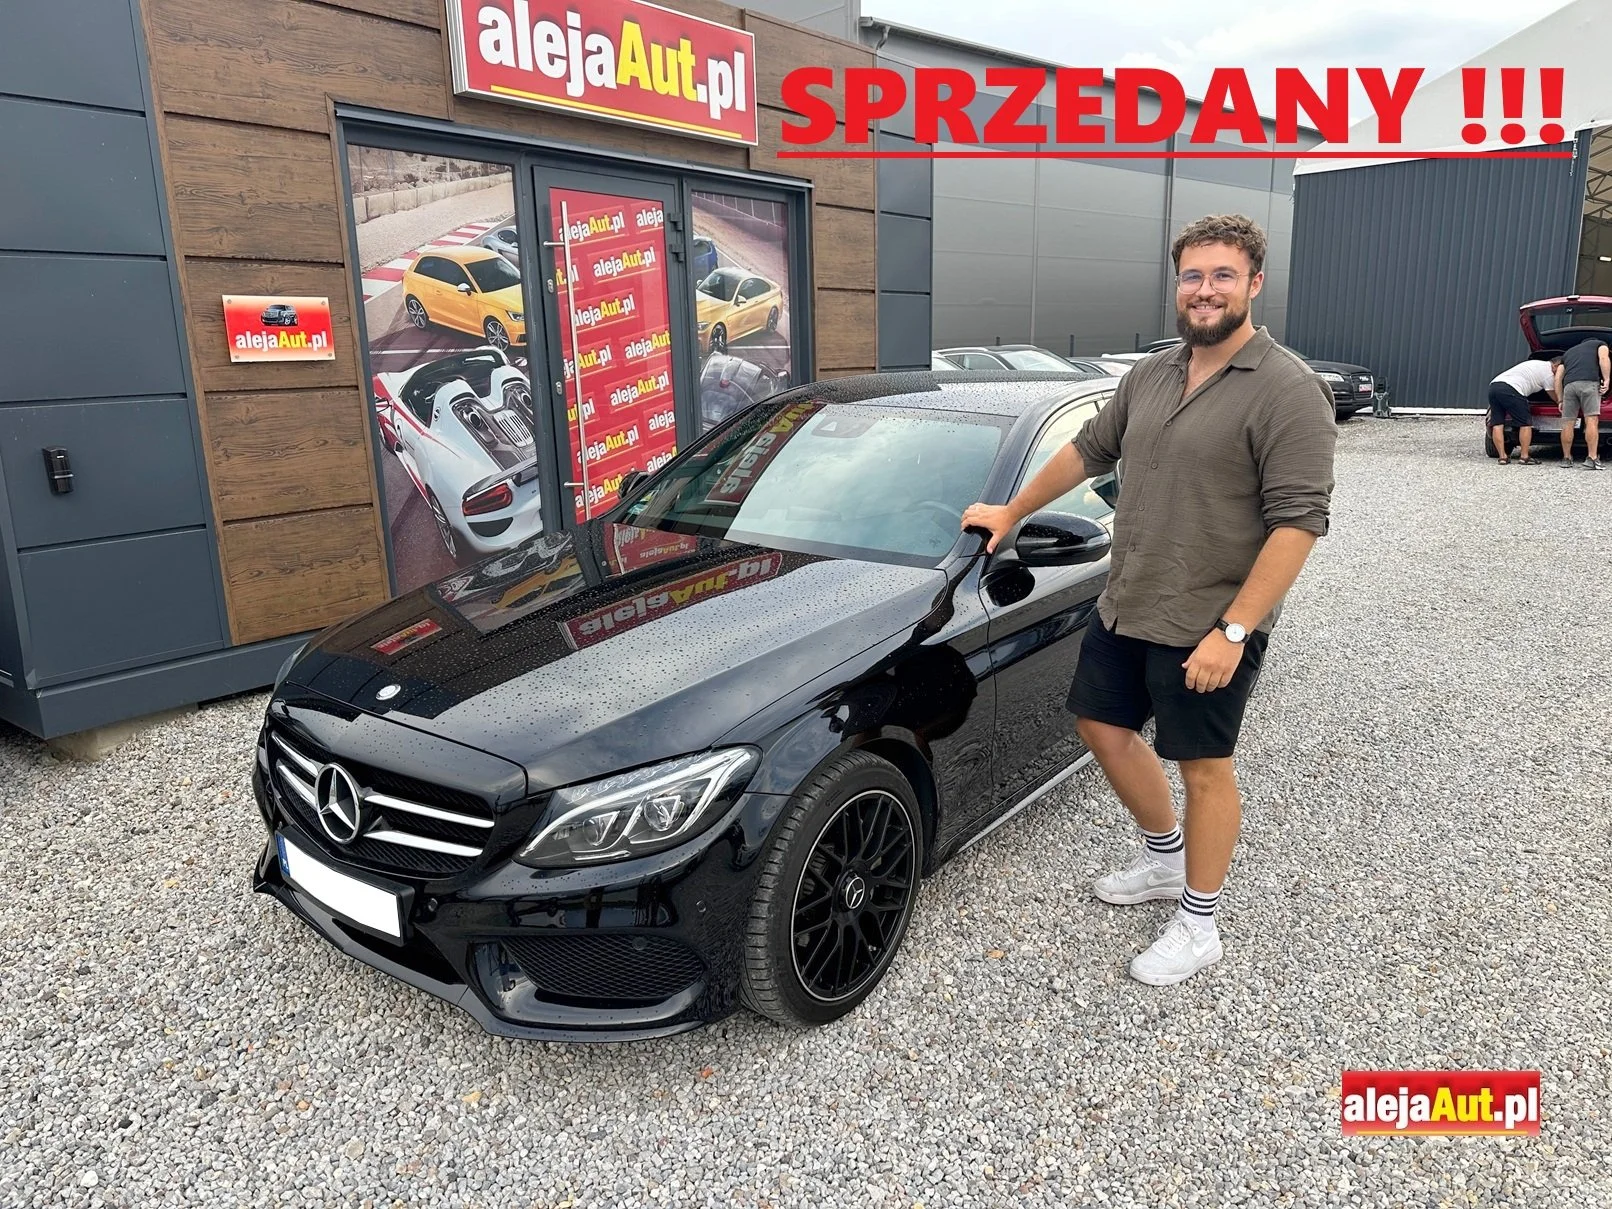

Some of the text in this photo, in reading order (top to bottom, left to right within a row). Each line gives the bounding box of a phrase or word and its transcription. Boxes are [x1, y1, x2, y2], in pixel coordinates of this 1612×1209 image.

[477, 0, 746, 120] alejaAut.pl
[593, 246, 656, 277] alejaAut.pl
[235, 330, 328, 352] alejaAut.pl
[609, 370, 670, 406] alejaAut.pl
[648, 409, 675, 430] aleja
